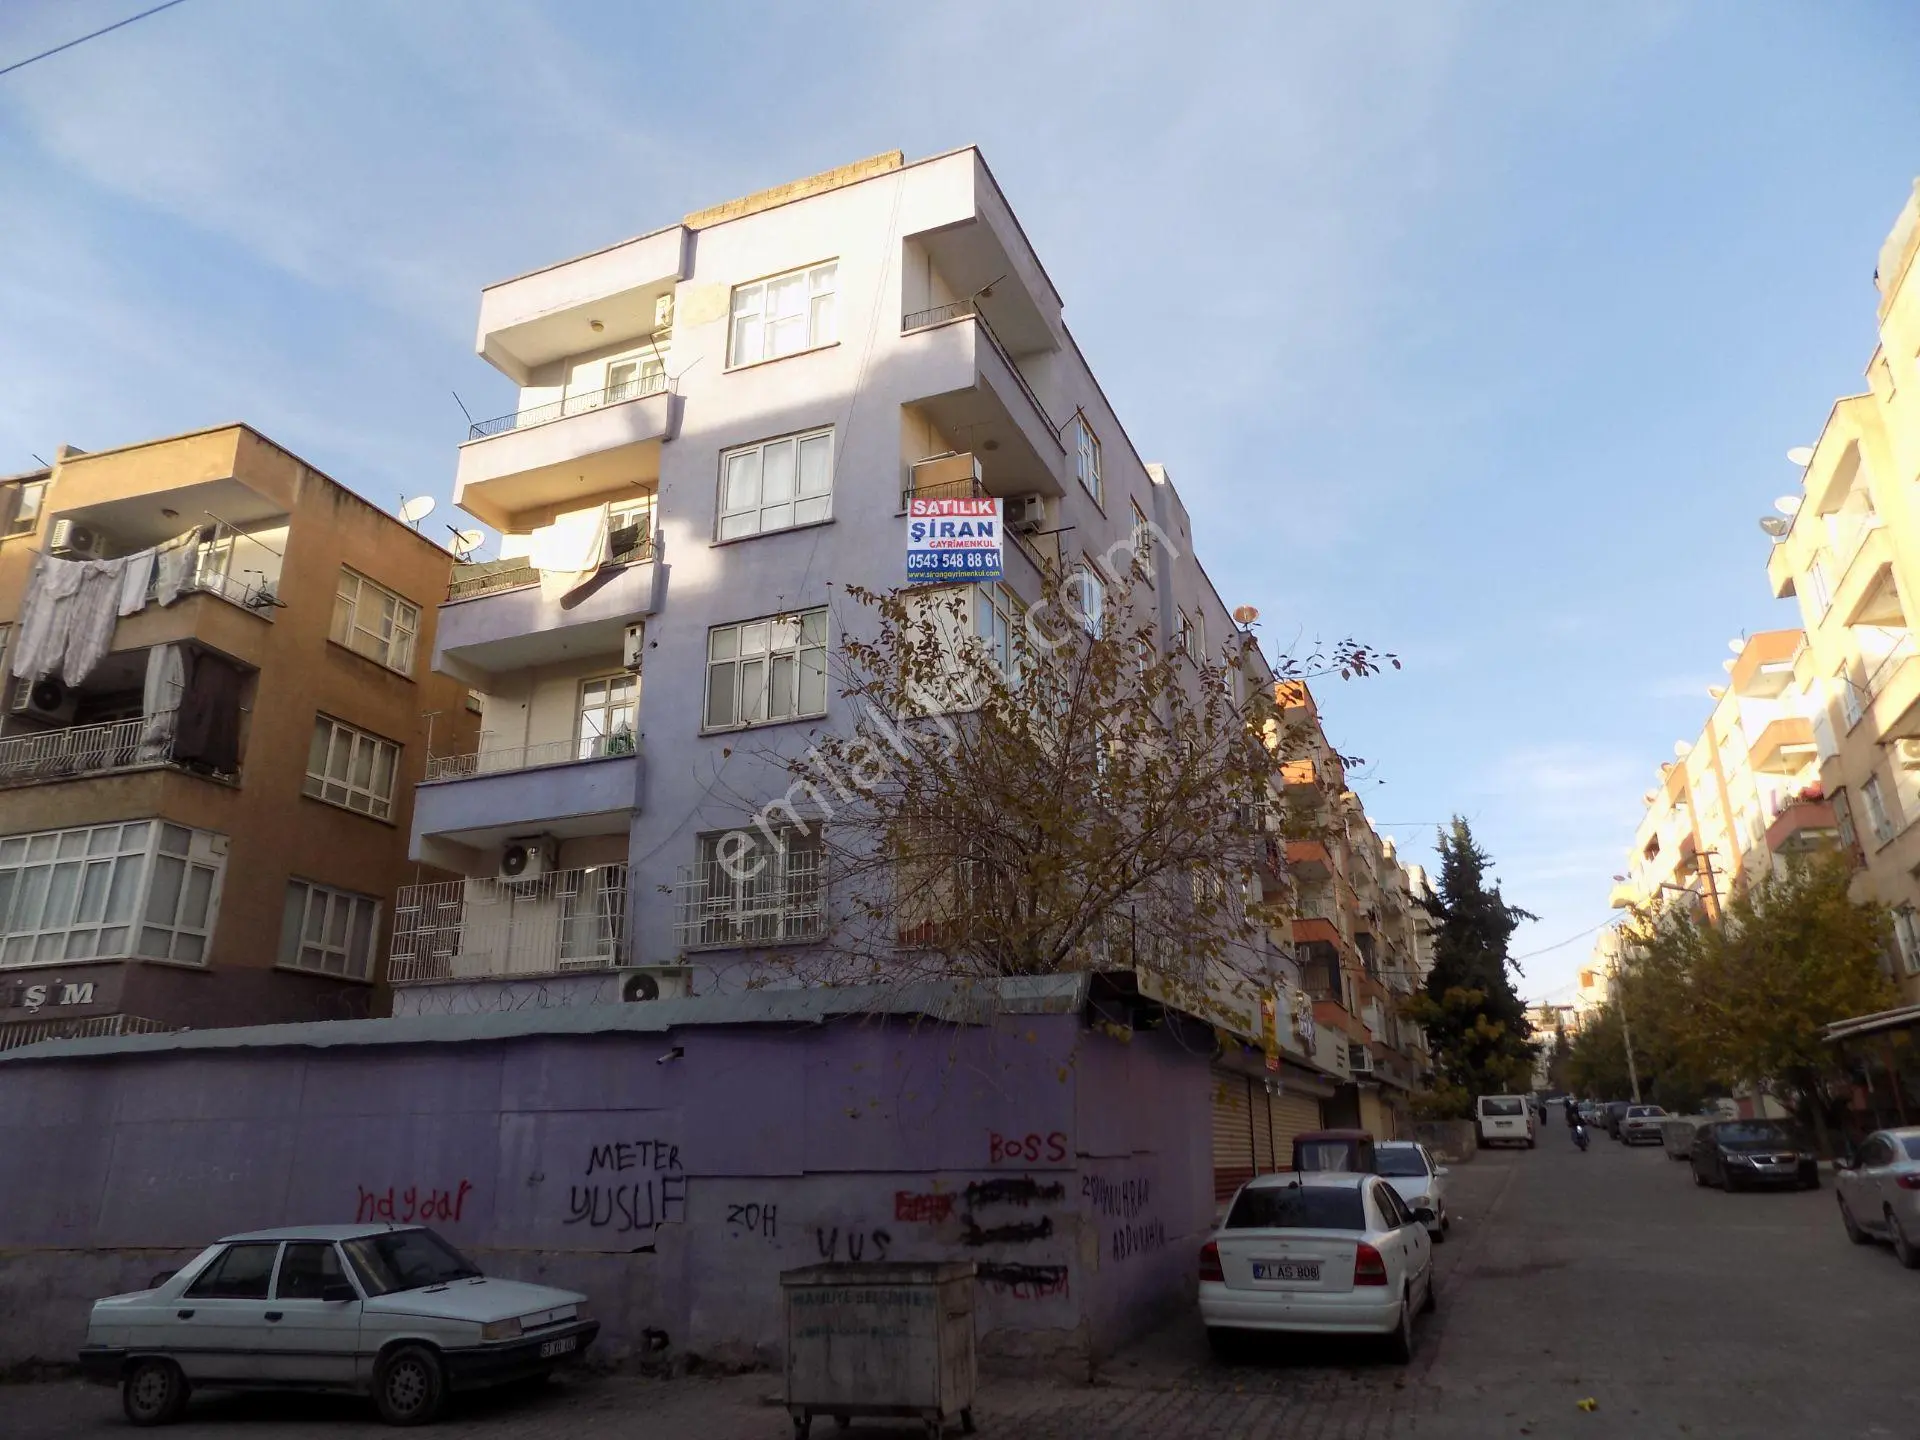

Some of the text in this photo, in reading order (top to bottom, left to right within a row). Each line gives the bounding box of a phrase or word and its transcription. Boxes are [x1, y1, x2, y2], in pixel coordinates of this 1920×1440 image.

[913, 500, 994, 515] SATILIK
[910, 518, 994, 542] ŞİRAN
[929, 540, 995, 549] GAYRİMENKUL
[908, 552, 999, 568] 0543 548 88 61
[585, 1139, 683, 1176] METER
[562, 1176, 684, 1232] YUSUF
[1277, 1265, 1293, 1278] AS
